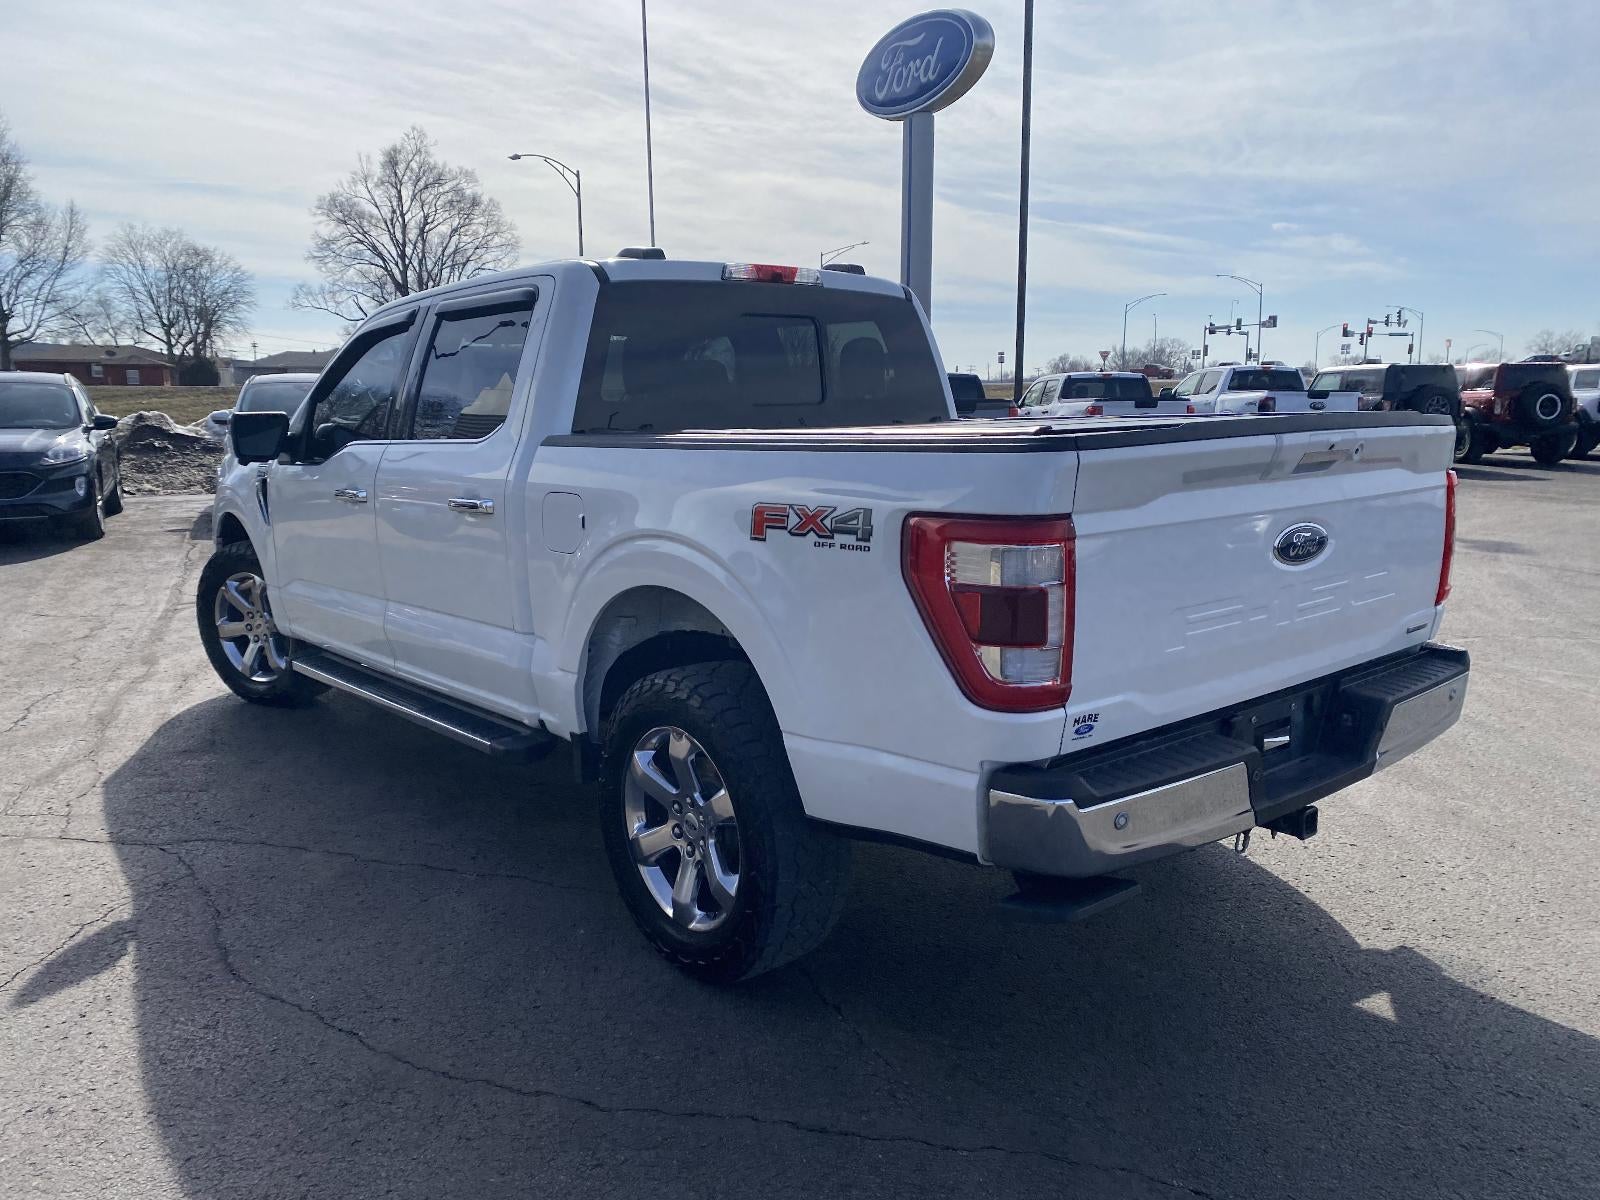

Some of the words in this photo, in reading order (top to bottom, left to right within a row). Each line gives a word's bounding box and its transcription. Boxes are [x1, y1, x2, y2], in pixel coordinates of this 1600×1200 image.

[874, 32, 943, 100] Ford
[750, 502, 873, 542] FX4
[813, 541, 836, 549] OFF
[839, 543, 871, 552] ROAD
[1289, 532, 1319, 557] Ford
